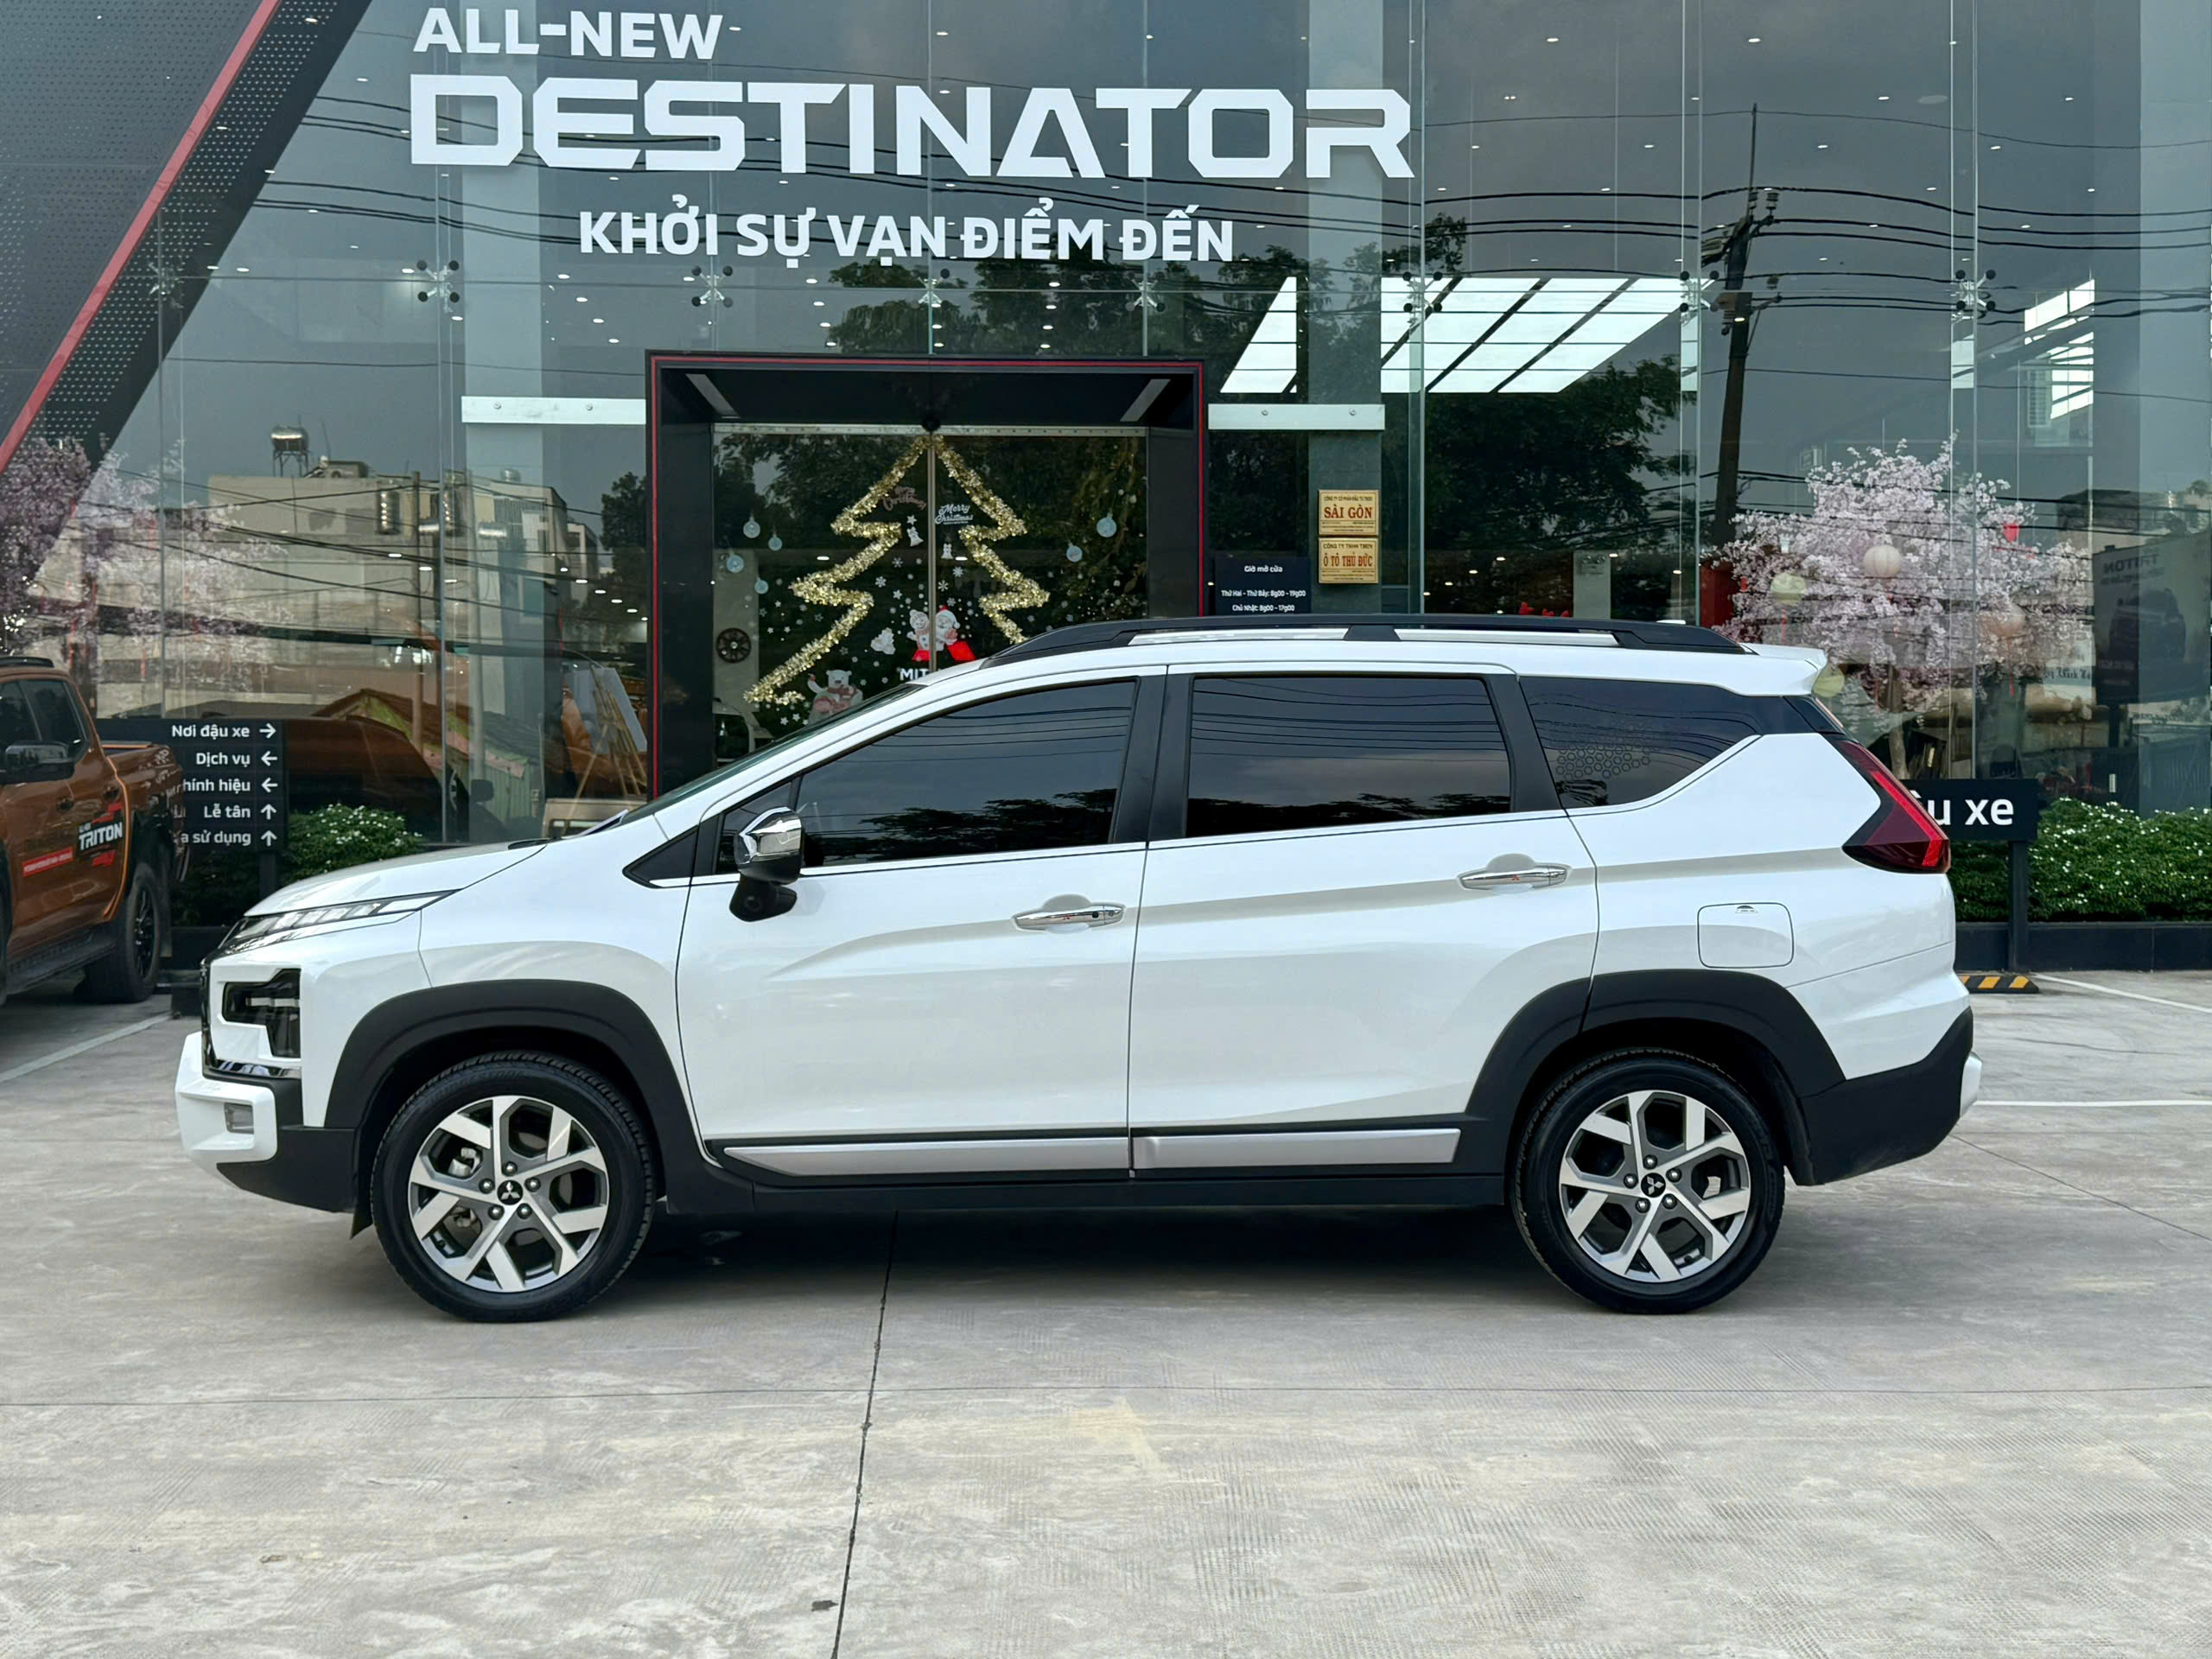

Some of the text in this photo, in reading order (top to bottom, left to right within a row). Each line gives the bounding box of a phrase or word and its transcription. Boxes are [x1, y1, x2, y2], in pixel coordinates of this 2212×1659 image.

[413, 7, 723, 60] ALL-NEW
[410, 74, 1415, 178] DESTINATOR
[580, 194, 1234, 269] KHỞI SỰ VẠN ĐIỂM ĐẾN
[938, 504, 970, 516] Merry
[1324, 504, 1372, 518] SÀI GÒN
[899, 668, 930, 681] MIT
[172, 724, 250, 740] Nơi đậu xe
[196, 752, 251, 767] Dịch vụ
[183, 778, 251, 794] hính hiệu
[204, 804, 251, 818] Lễ tân
[1965, 798, 2014, 825] xe
[79, 822, 123, 850] TRITON
[193, 830, 211, 843] sử
[214, 831, 251, 846] dụng
